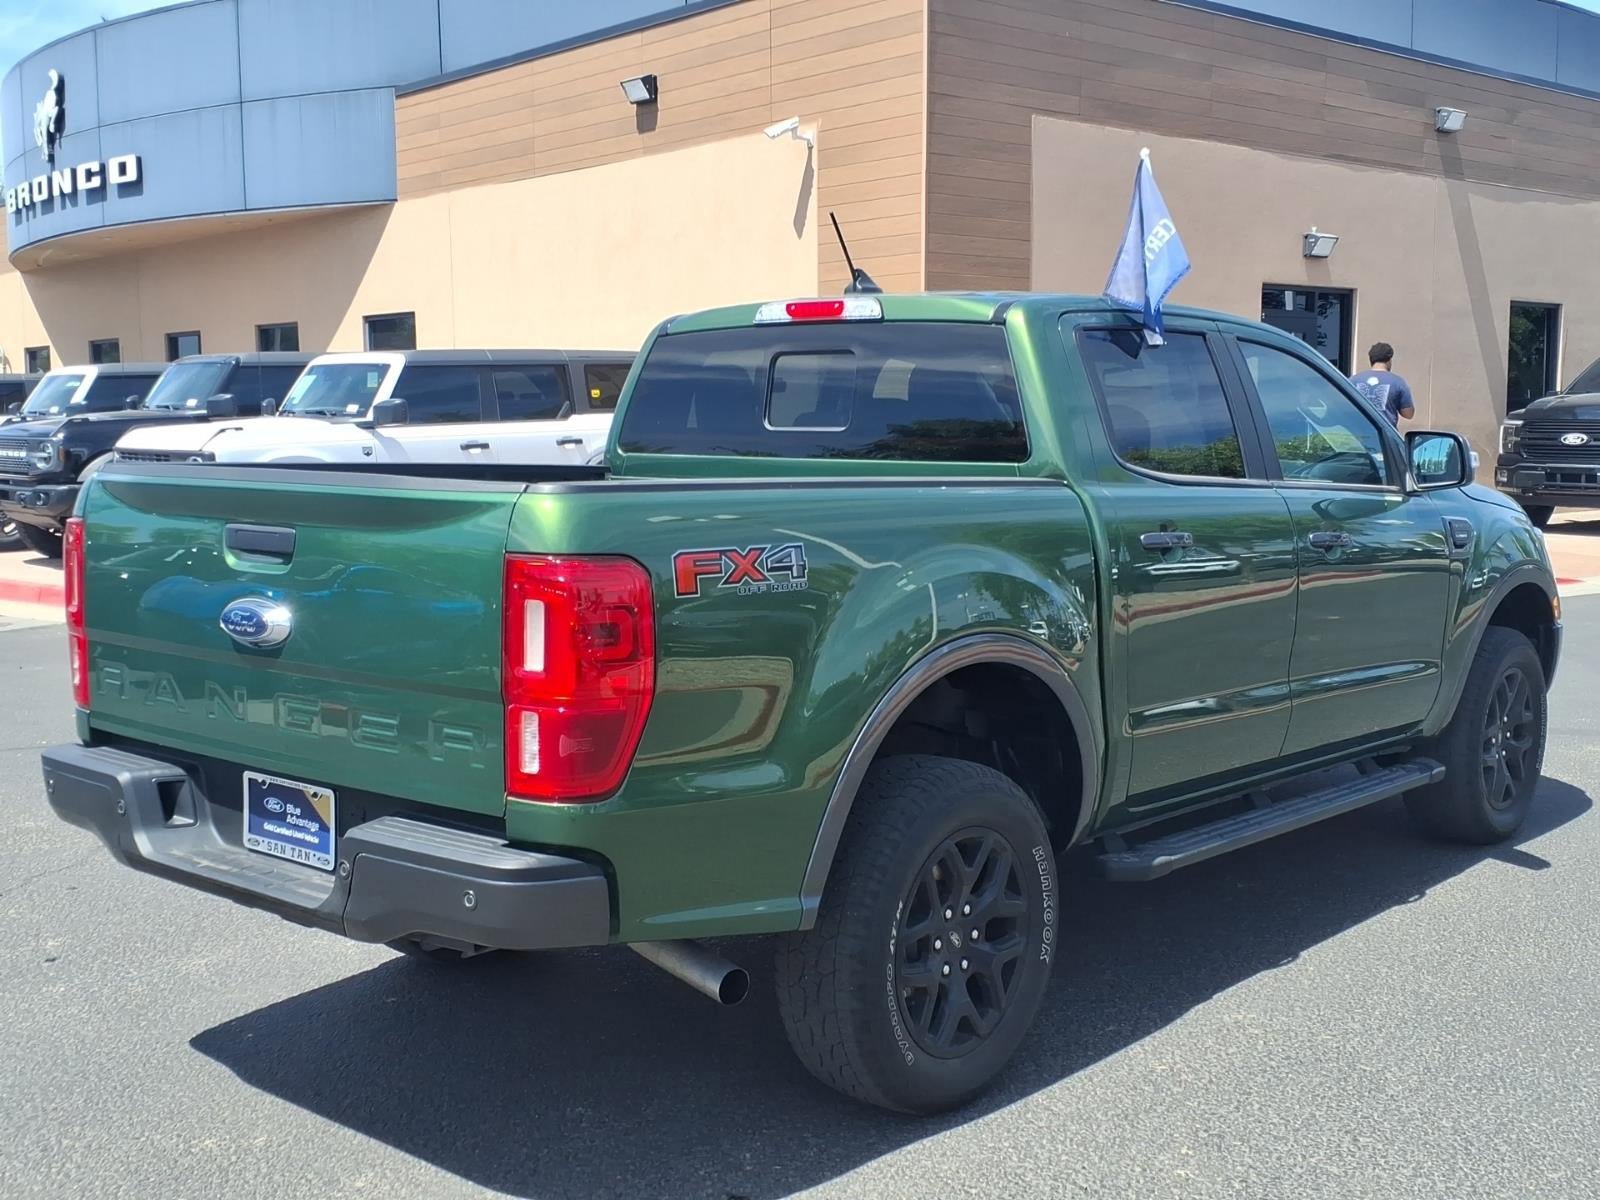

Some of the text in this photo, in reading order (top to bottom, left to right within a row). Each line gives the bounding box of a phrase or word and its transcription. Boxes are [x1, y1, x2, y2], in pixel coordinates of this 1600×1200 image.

[6, 153, 138, 214] BRONCO
[672, 543, 808, 598] FX4
[737, 582, 808, 596] OFF ROAD
[96, 659, 485, 768] RANGER
[286, 804, 301, 815] Blue
[286, 815, 319, 832] Advantage
[266, 841, 286, 855] SAN
[290, 847, 311, 862] TAN
